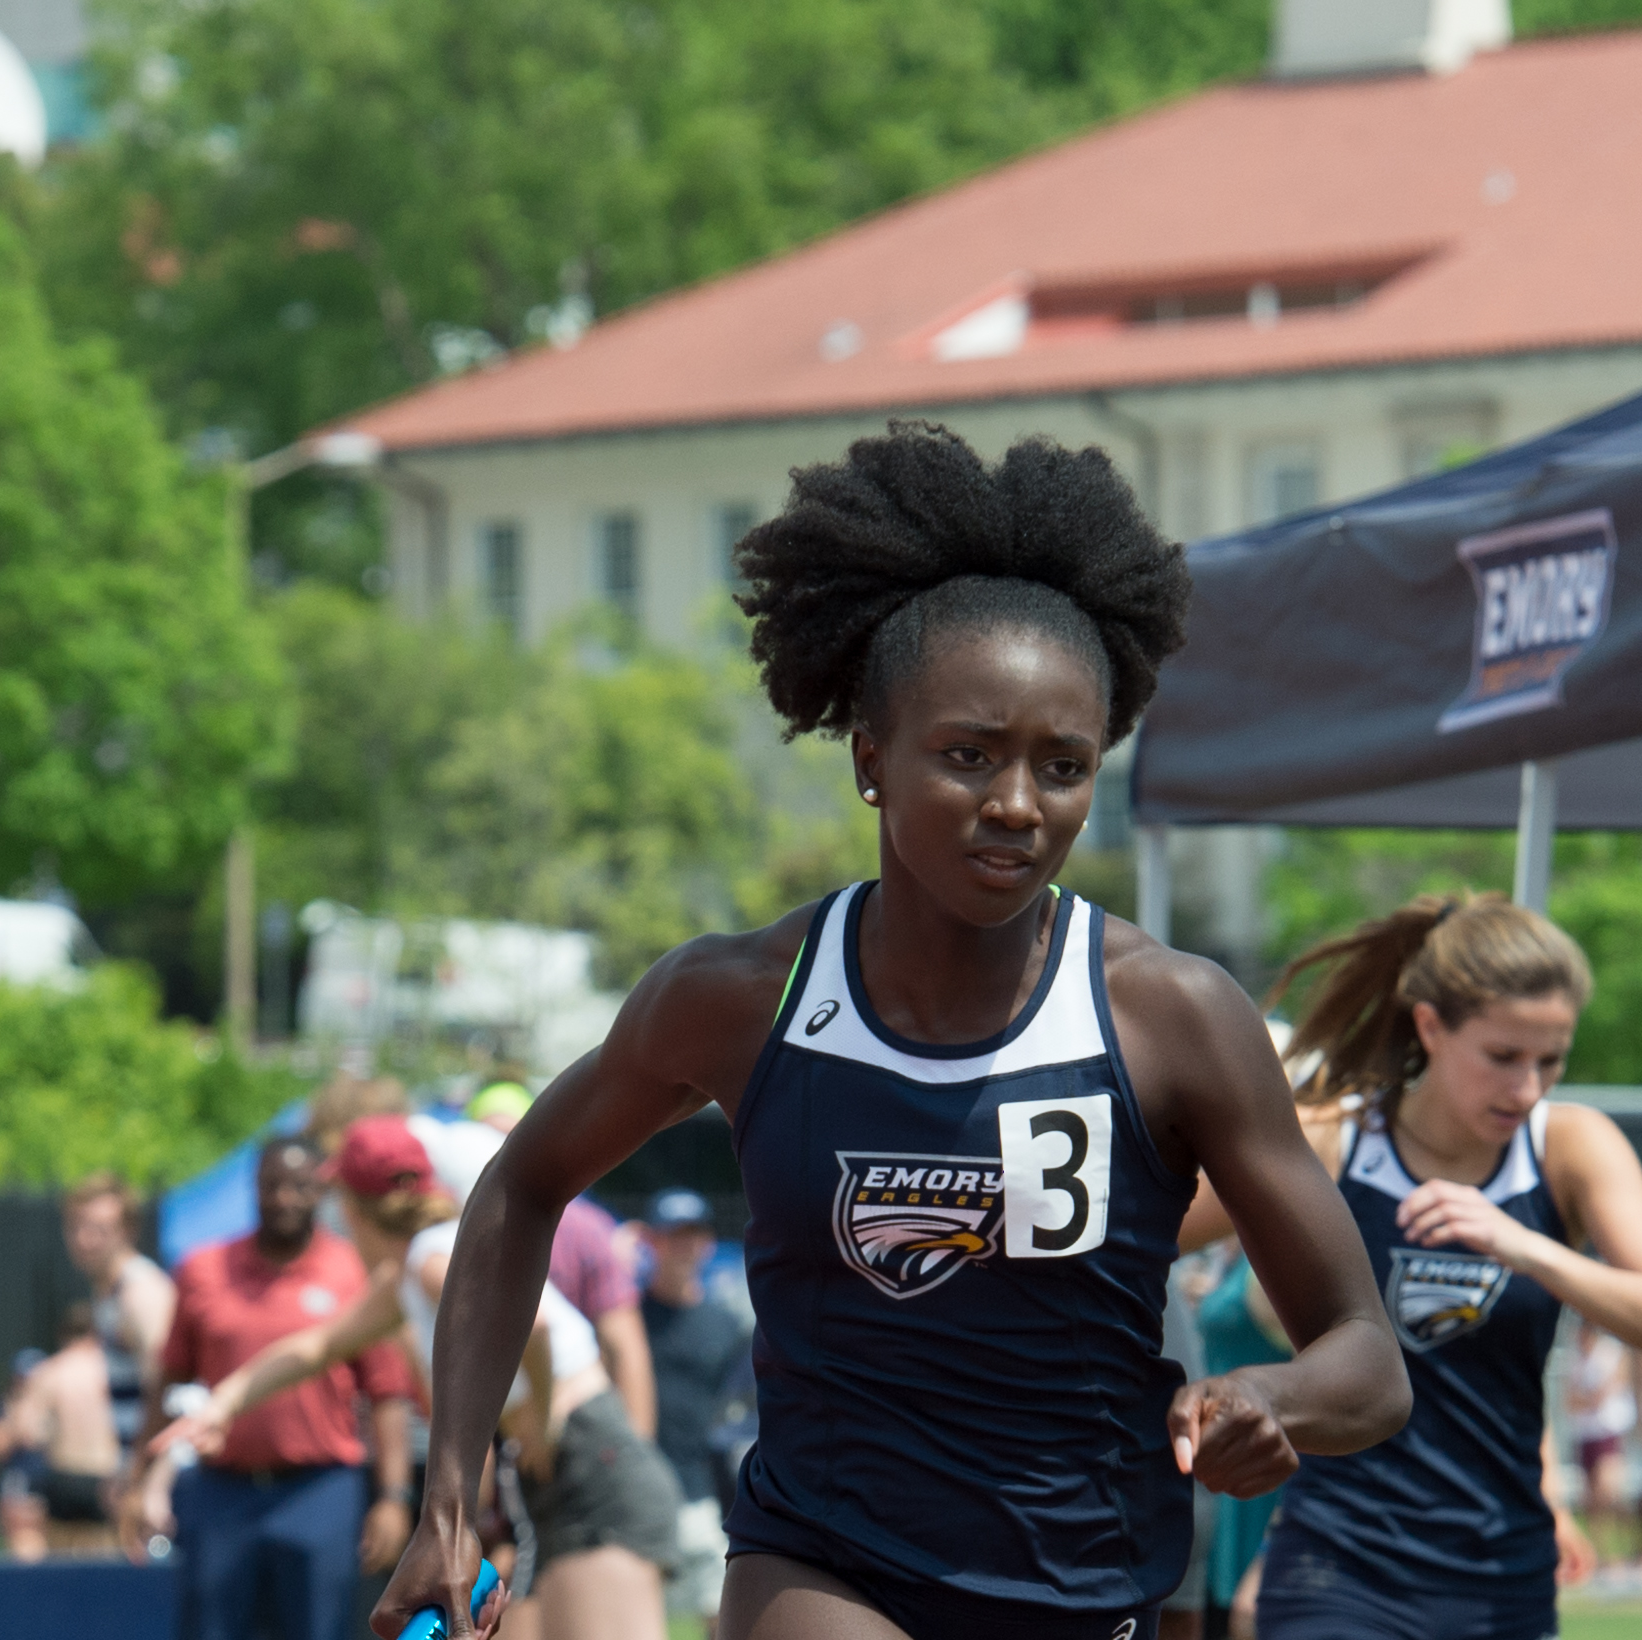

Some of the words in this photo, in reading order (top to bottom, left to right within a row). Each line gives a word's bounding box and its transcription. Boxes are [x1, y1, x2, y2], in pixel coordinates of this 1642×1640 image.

[1480, 547, 1608, 659] EMORY
[857, 1190, 994, 1208] EAGLES
[862, 1166, 1004, 1193] EMORY
[1030, 1110, 1089, 1251] 3
